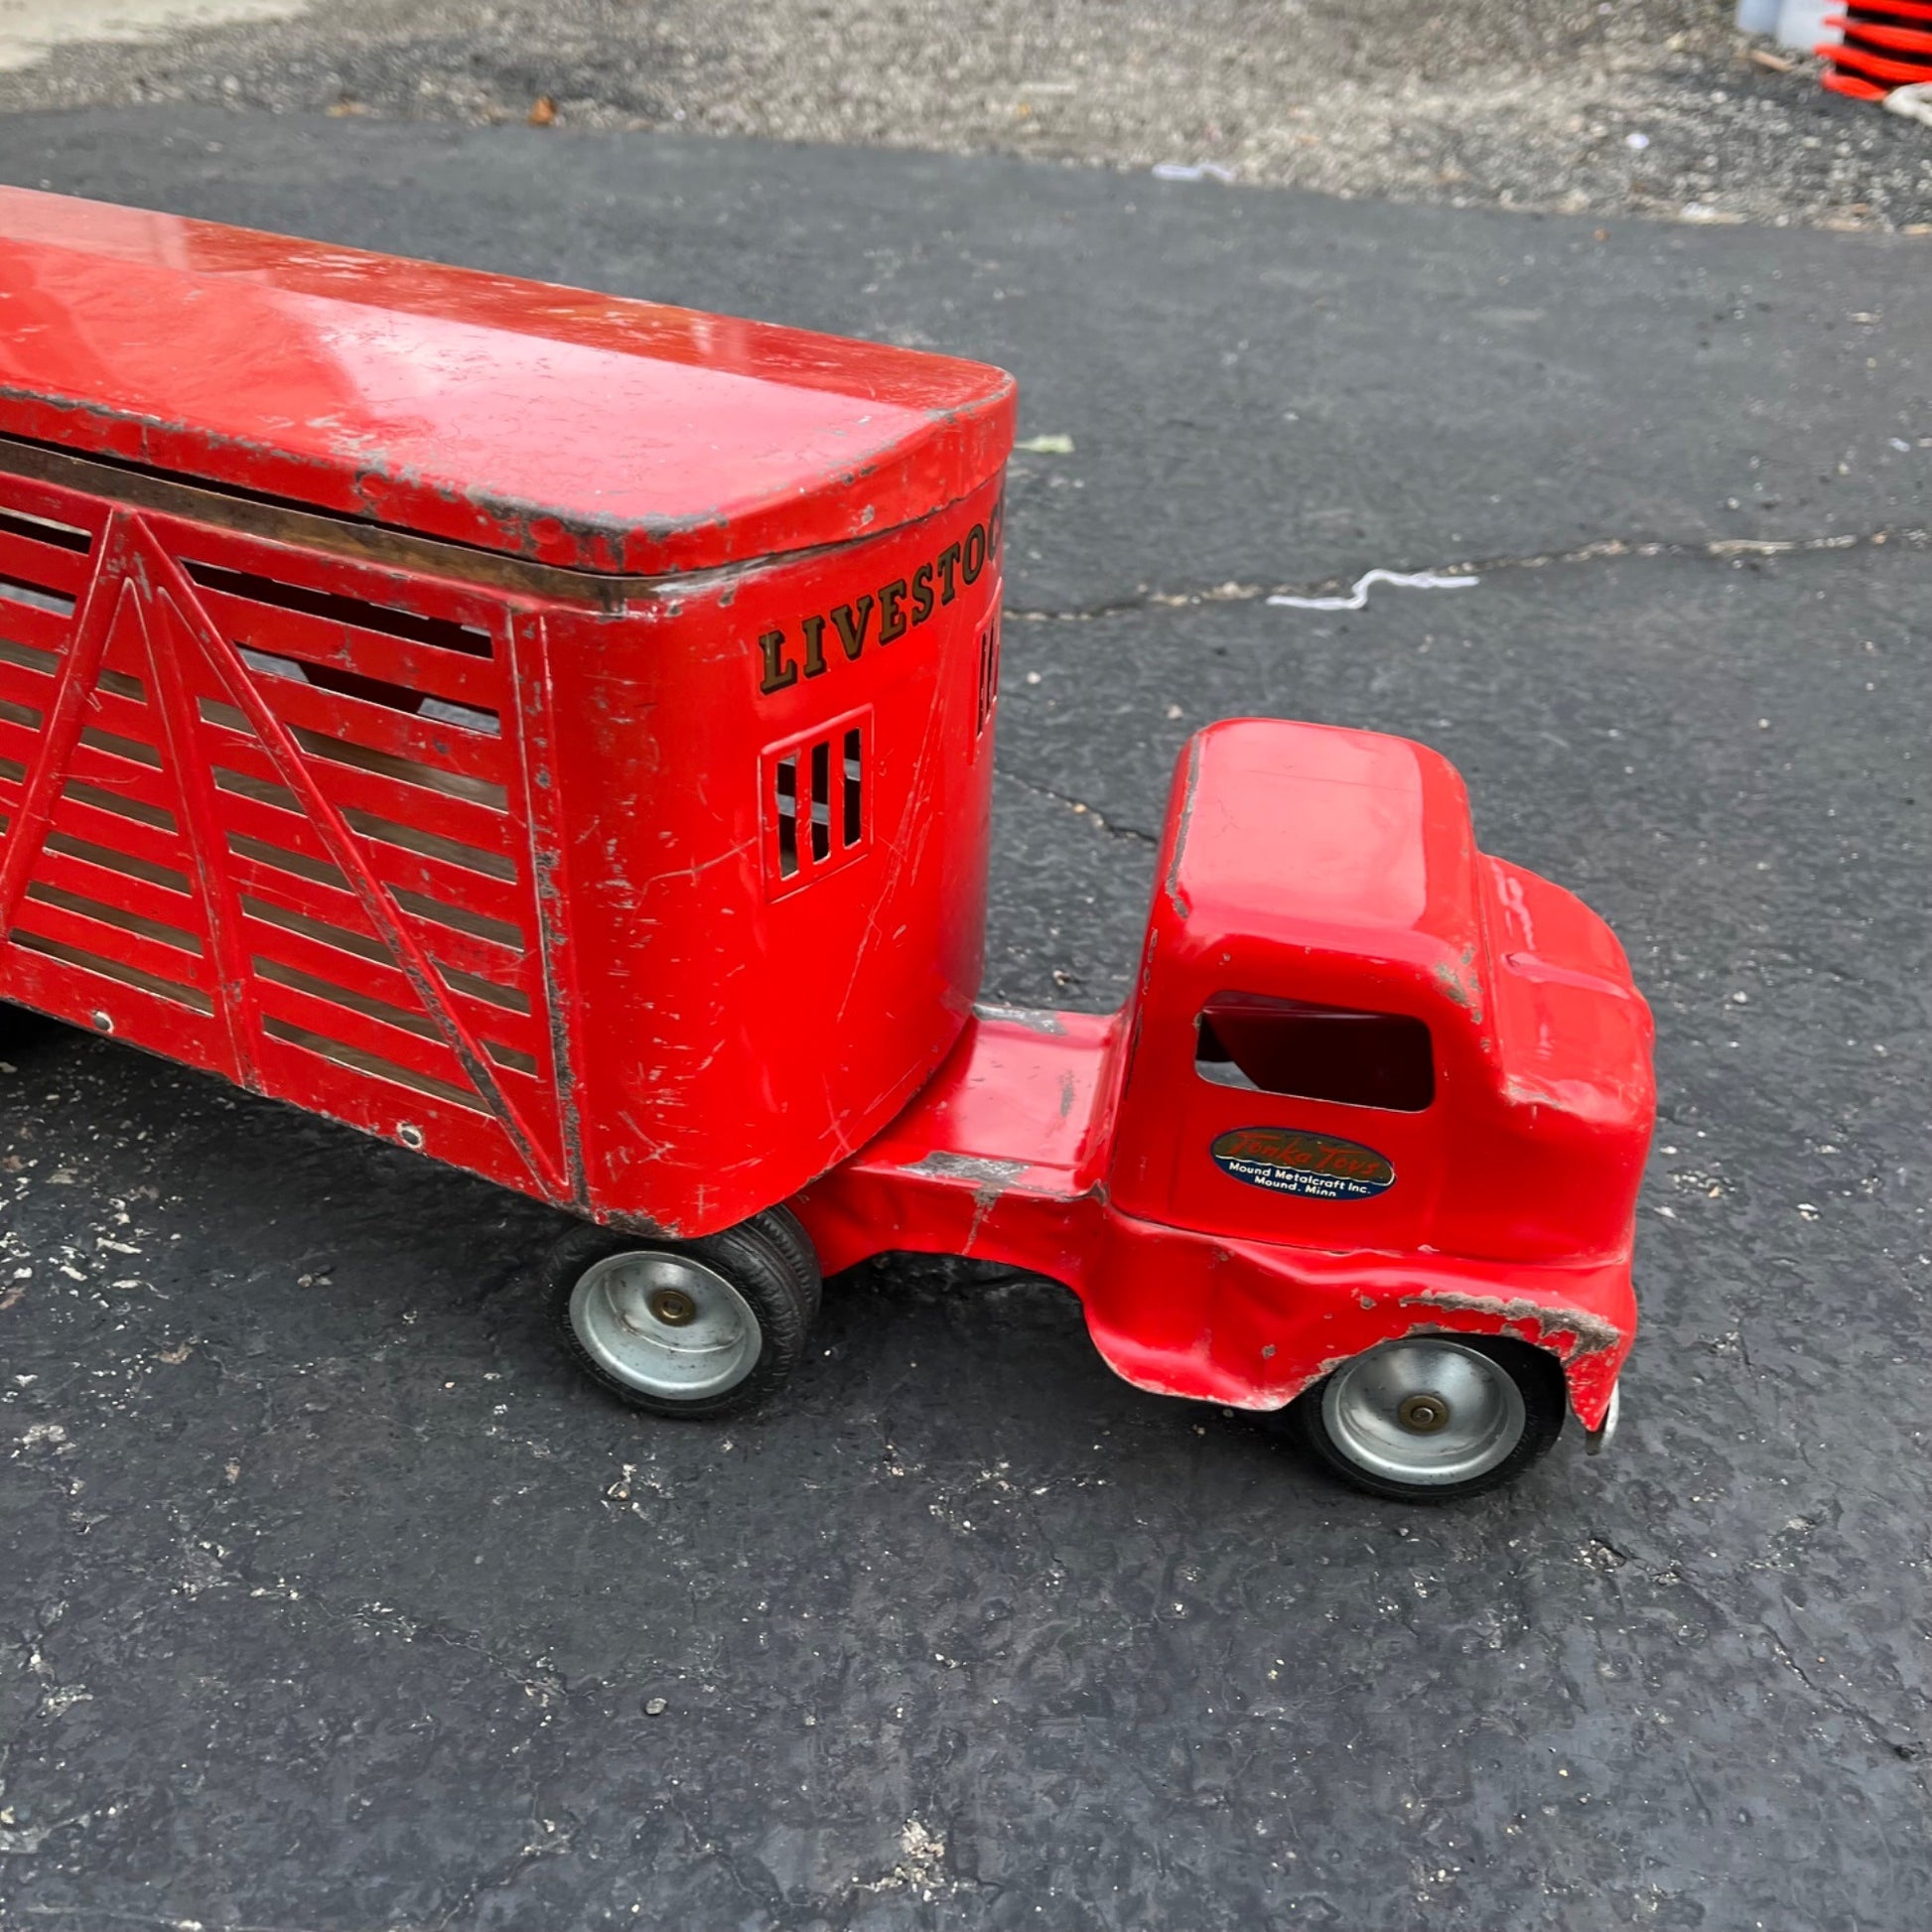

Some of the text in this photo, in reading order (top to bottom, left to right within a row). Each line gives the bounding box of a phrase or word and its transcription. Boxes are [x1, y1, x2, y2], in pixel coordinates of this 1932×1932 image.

[759, 493, 1005, 695] LIVESTOC
[1229, 1133, 1381, 1176] Tonka Toys
[1228, 1162, 1371, 1194] Mound Metalcraft Inc.
[1305, 1185, 1336, 1197] Minn
